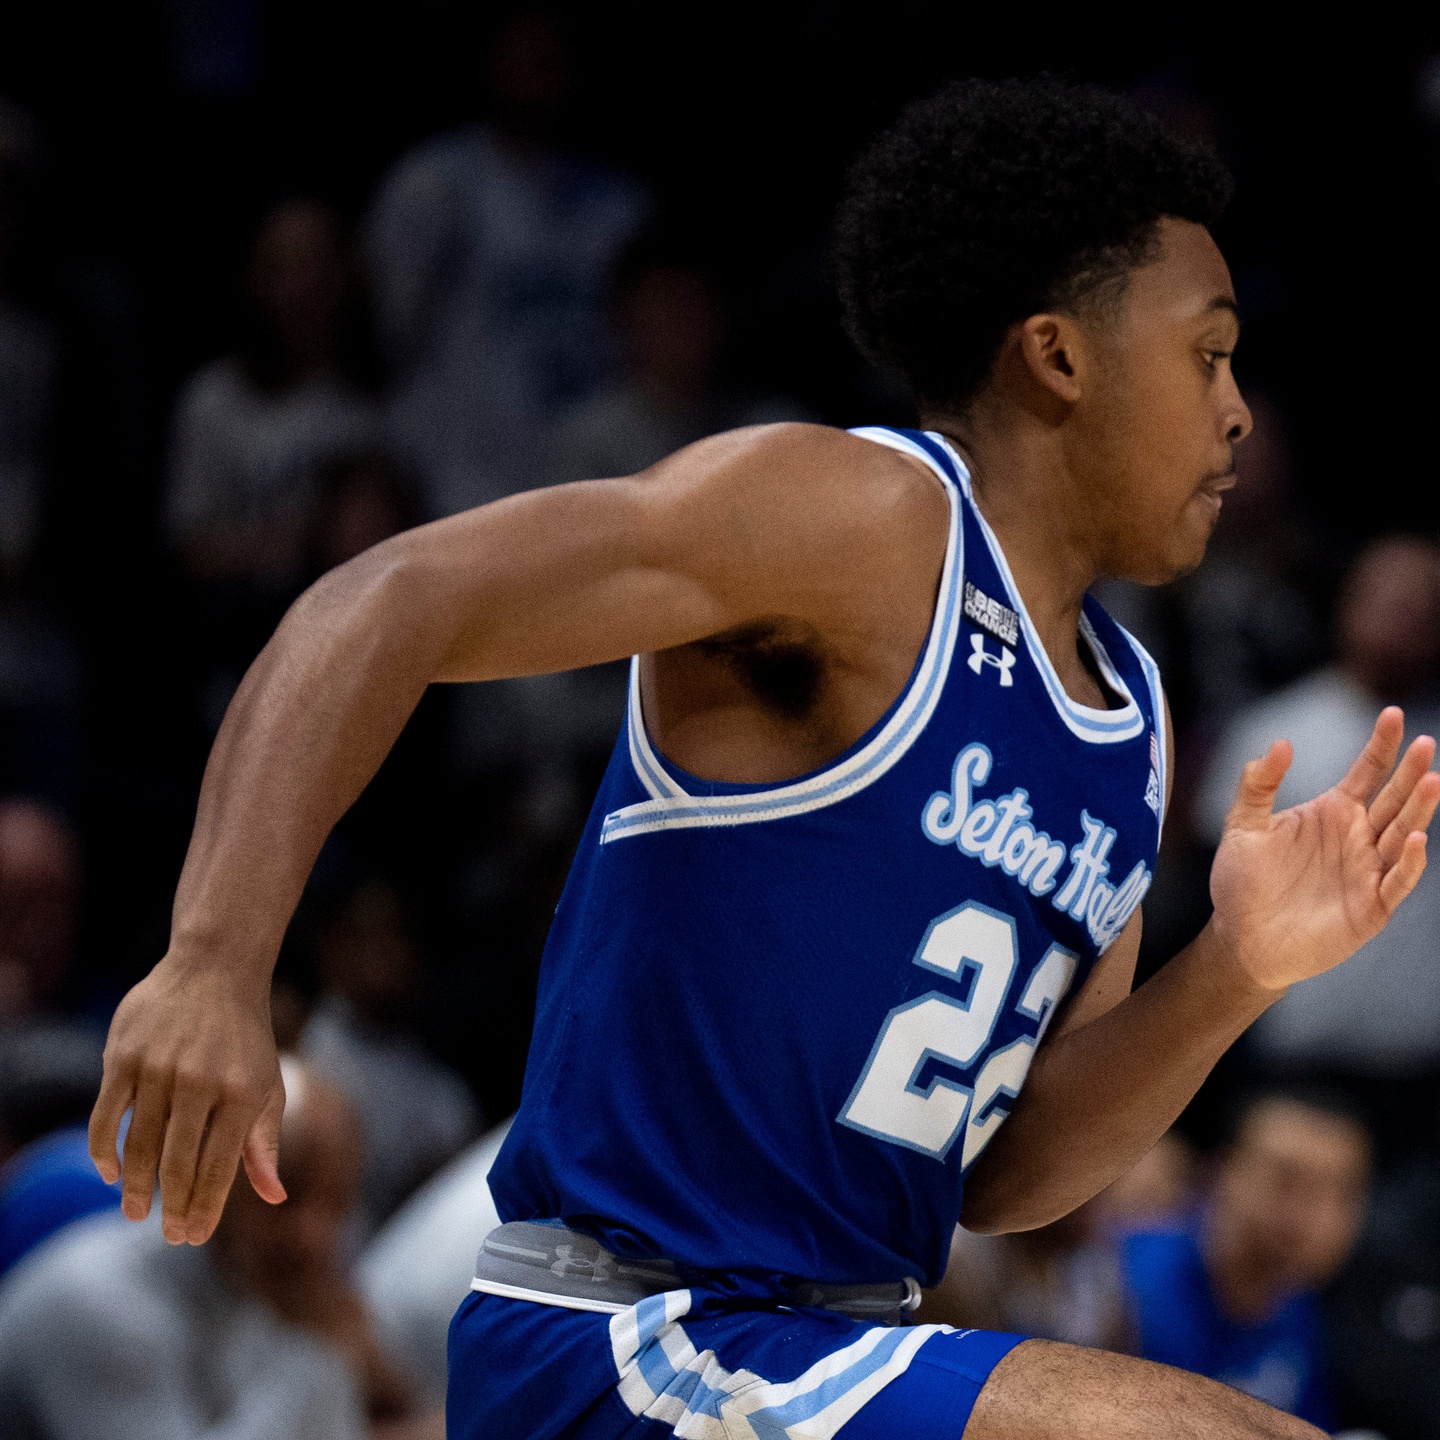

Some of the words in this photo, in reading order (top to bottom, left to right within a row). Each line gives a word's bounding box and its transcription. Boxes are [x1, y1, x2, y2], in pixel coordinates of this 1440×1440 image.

[964, 600, 1019, 647] CHANGE
[920, 742, 1067, 897] Seton
[1052, 808, 1153, 957] Hall
[835, 899, 1081, 1174] 22
